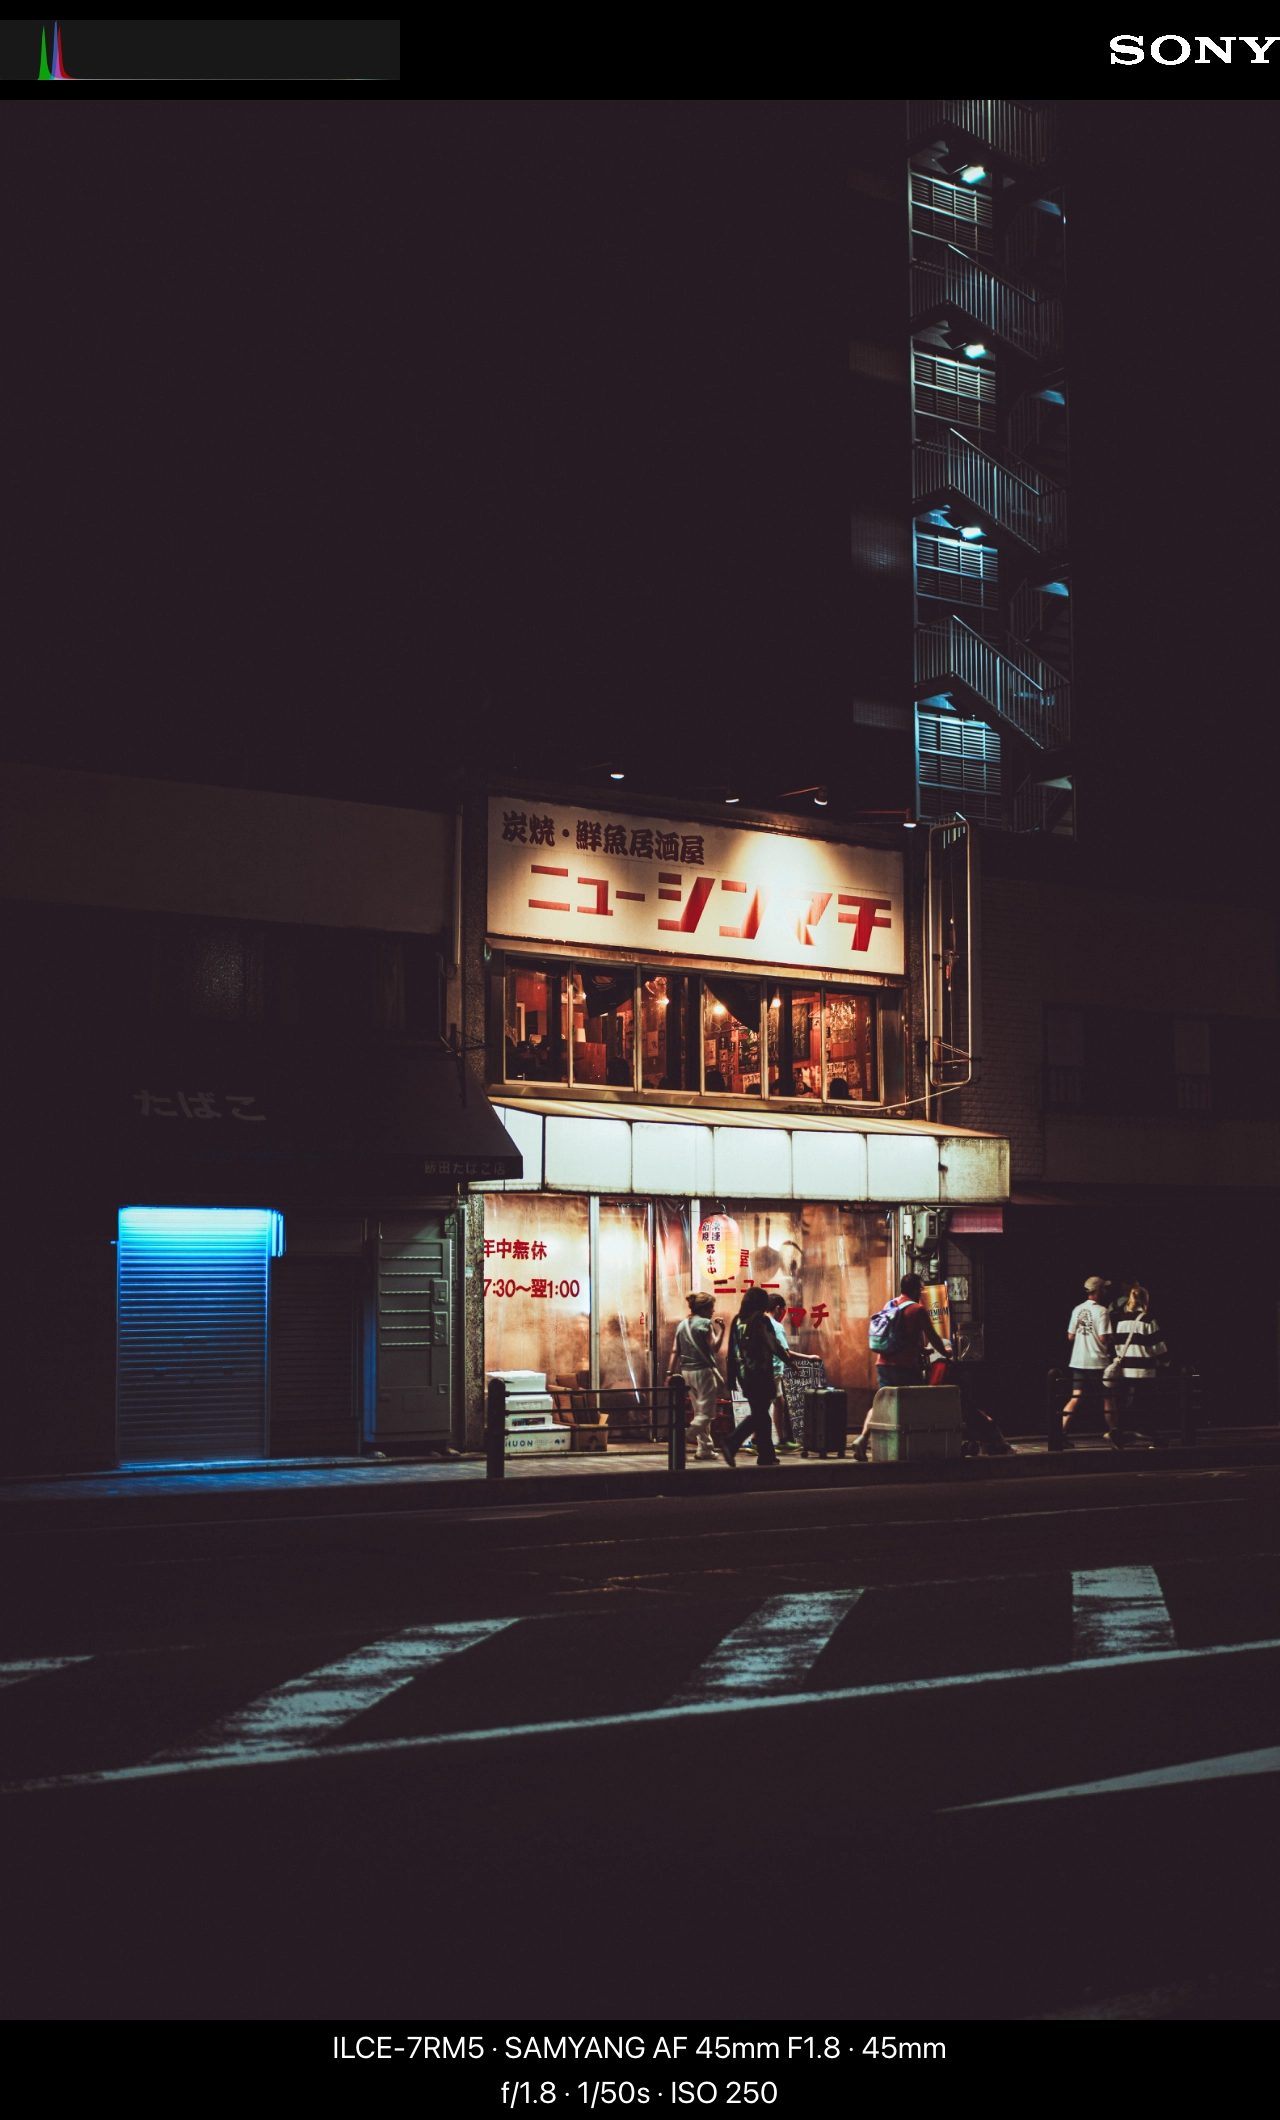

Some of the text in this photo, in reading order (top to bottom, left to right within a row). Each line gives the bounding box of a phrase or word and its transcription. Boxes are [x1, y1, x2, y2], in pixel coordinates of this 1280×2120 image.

[502, 810, 705, 865] 炭焼・鮮魚居酒屋
[133, 1089, 267, 1122] たばこ
